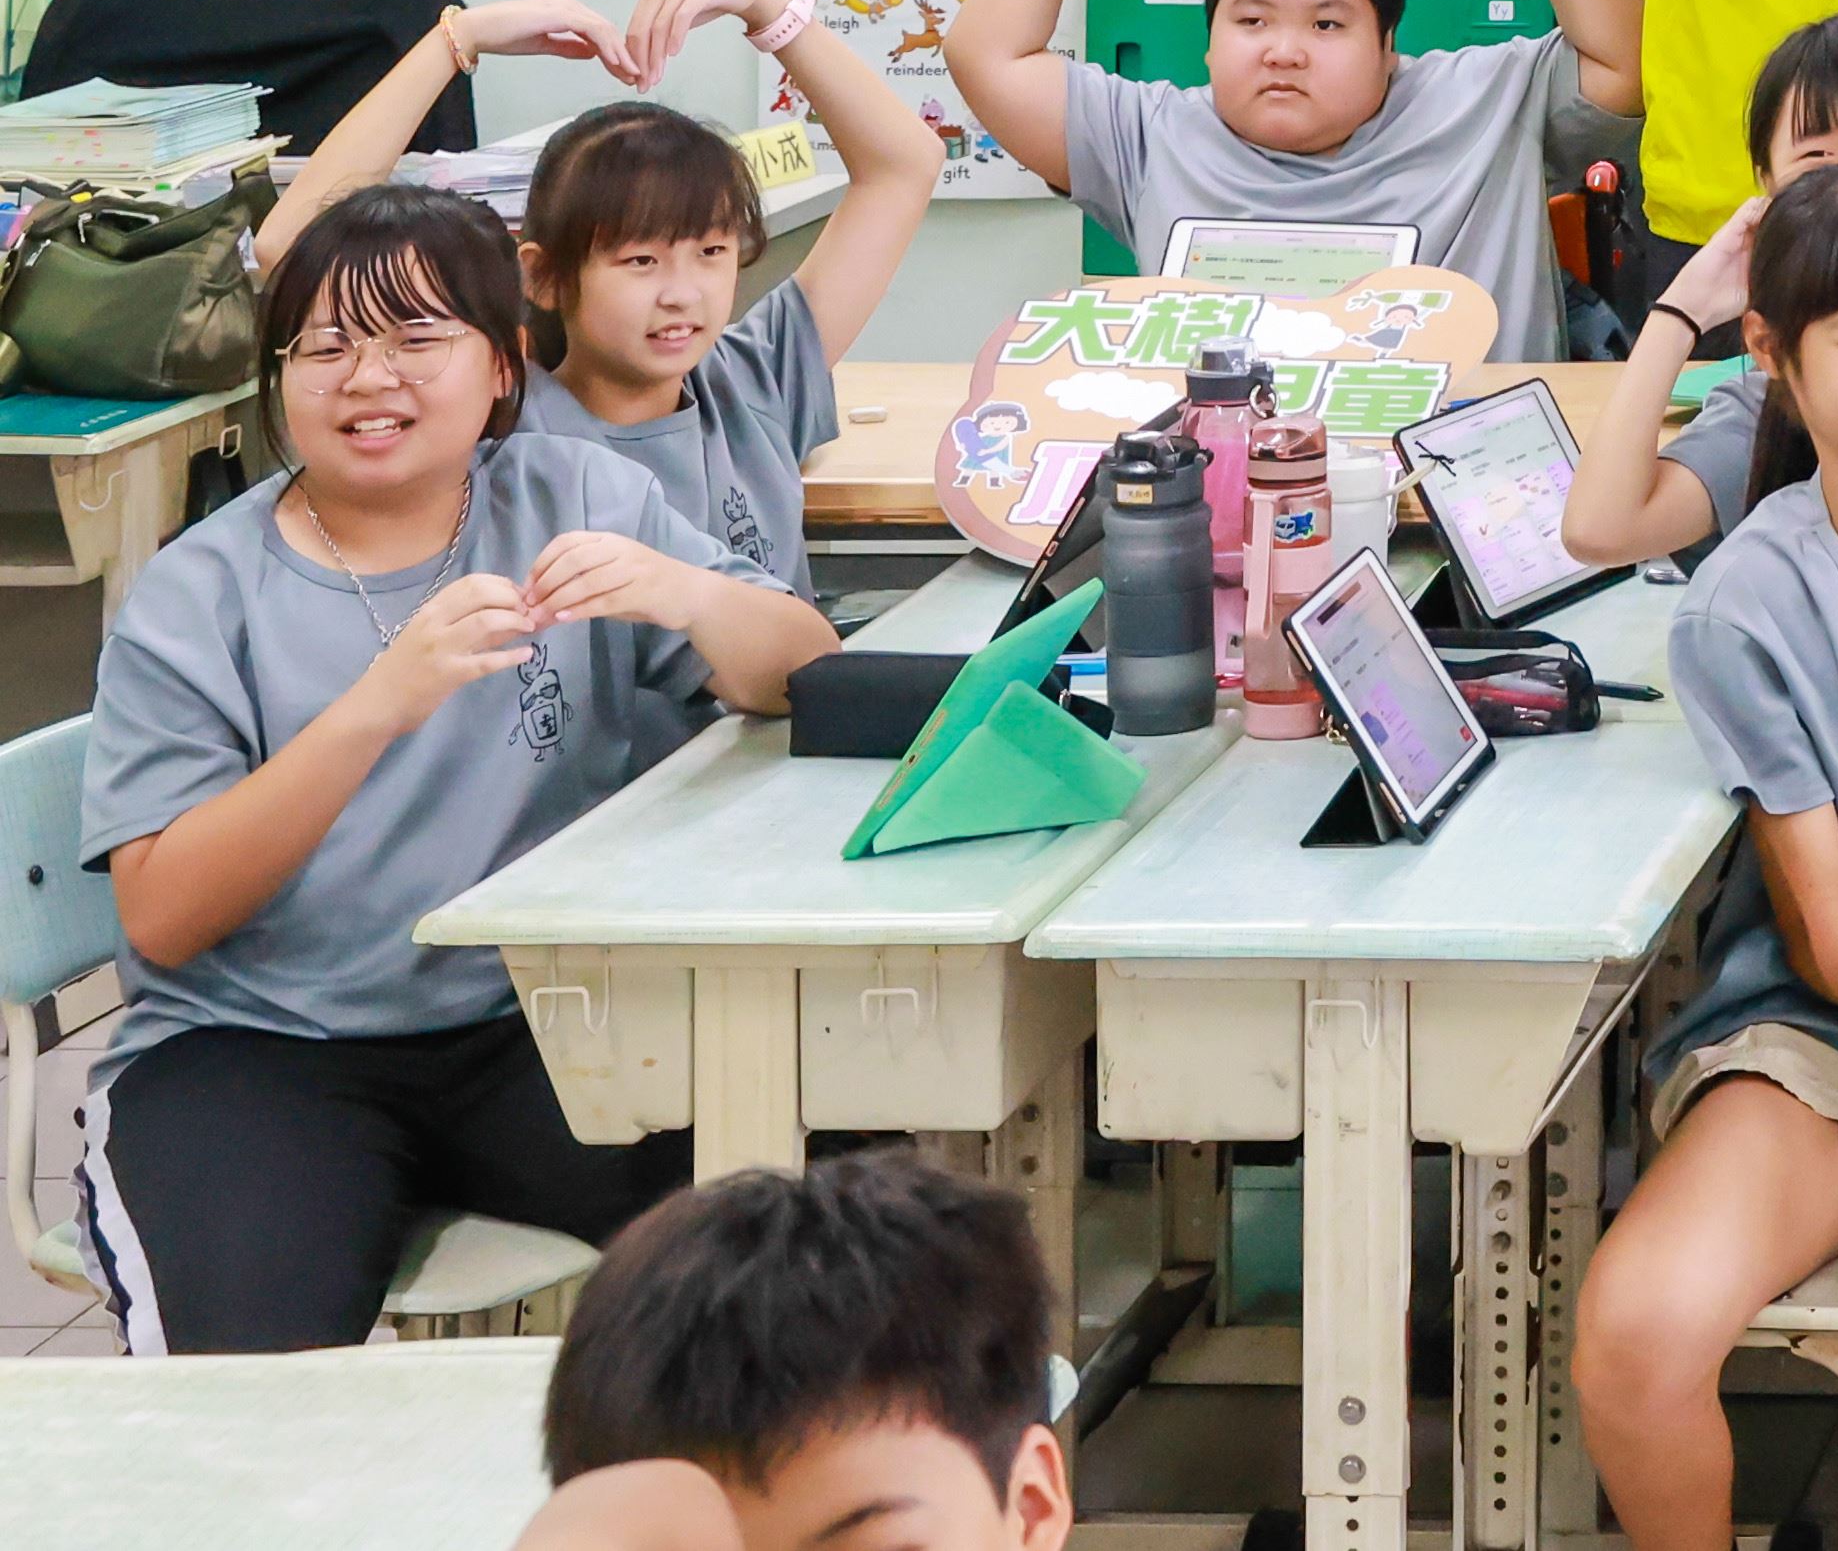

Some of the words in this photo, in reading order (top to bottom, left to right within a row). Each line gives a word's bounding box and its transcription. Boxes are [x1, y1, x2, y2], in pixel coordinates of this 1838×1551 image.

[885, 63, 950, 77] reindeer
[752, 131, 808, 179] 小成
[943, 165, 971, 183] gift
[997, 289, 1264, 366] 大樹
